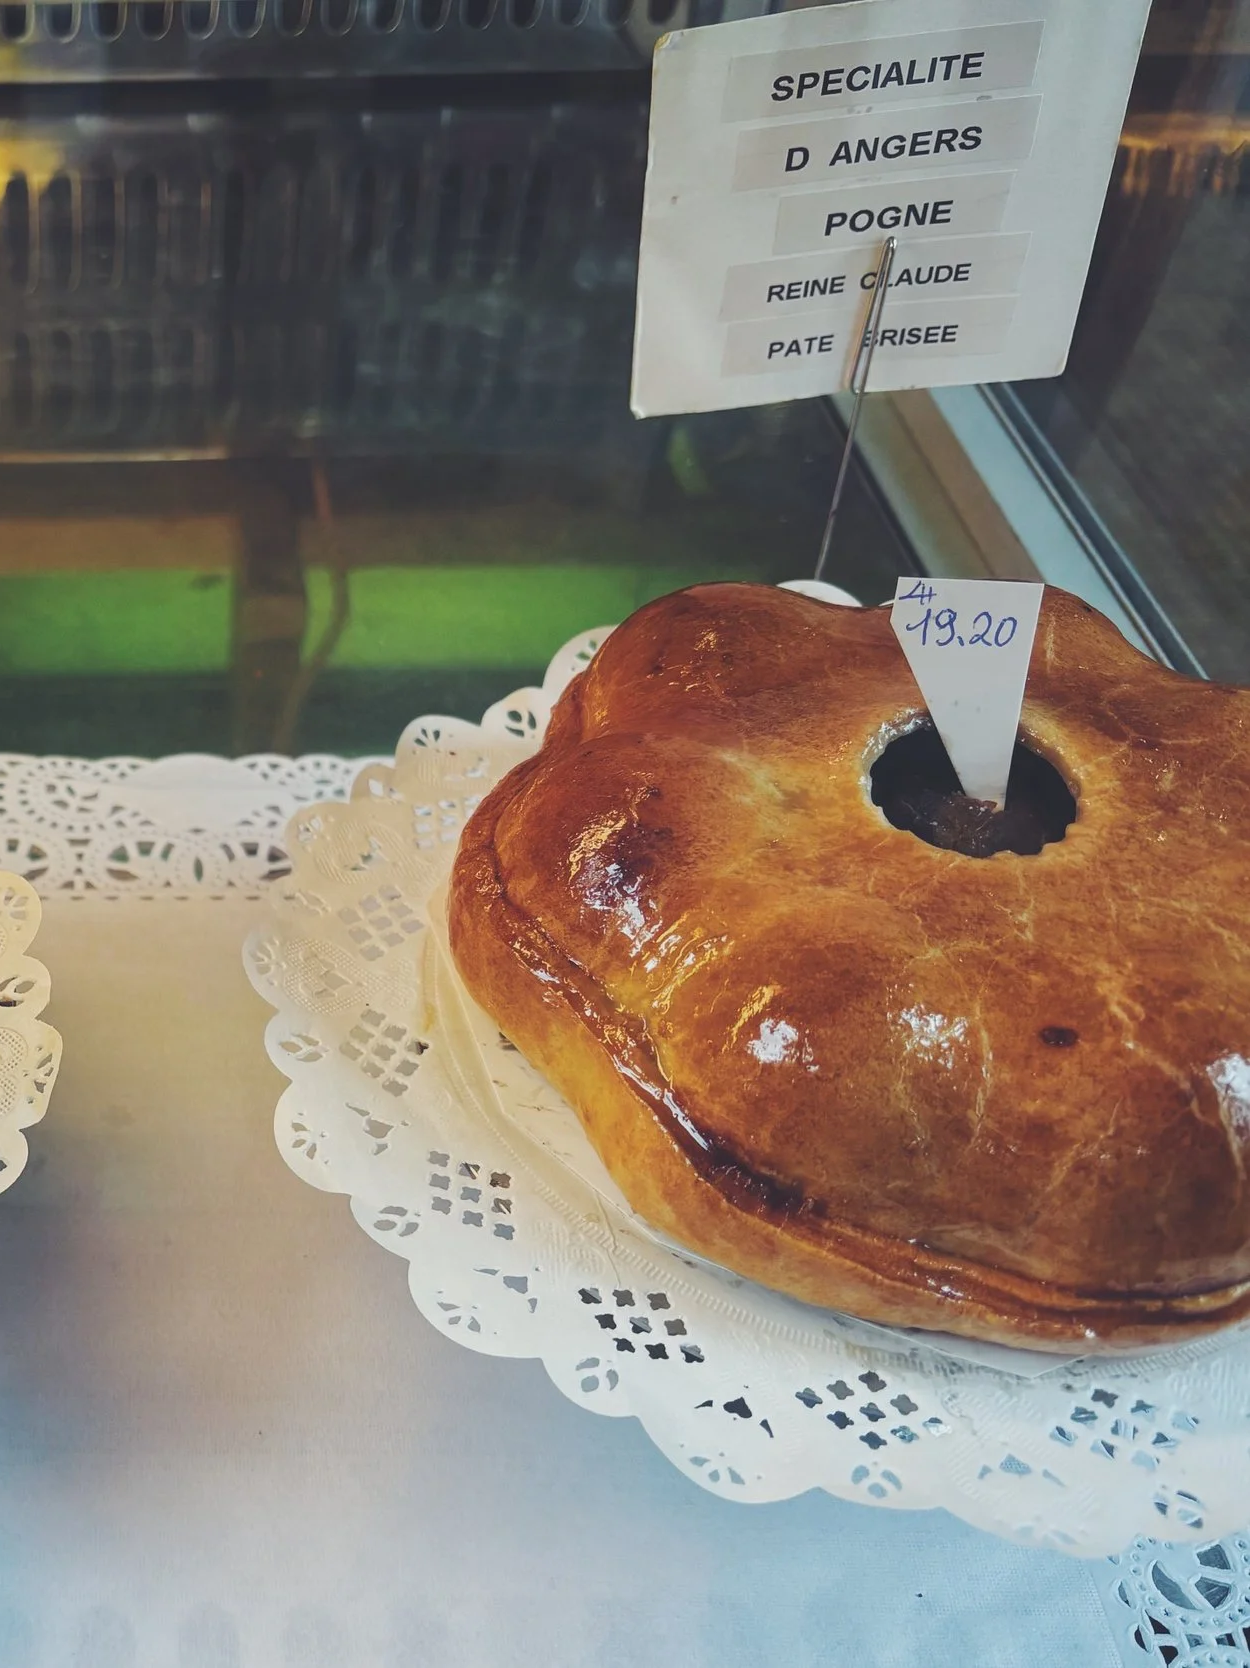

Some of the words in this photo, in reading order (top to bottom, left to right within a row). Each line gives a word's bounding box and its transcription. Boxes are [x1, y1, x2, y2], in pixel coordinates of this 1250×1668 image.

[771, 52, 985, 101] SPECIALITE
[785, 147, 810, 172] D
[829, 126, 983, 166] ANGERS
[824, 200, 953, 236] POGNE
[767, 275, 846, 303] REINE
[768, 335, 835, 359] PATE
